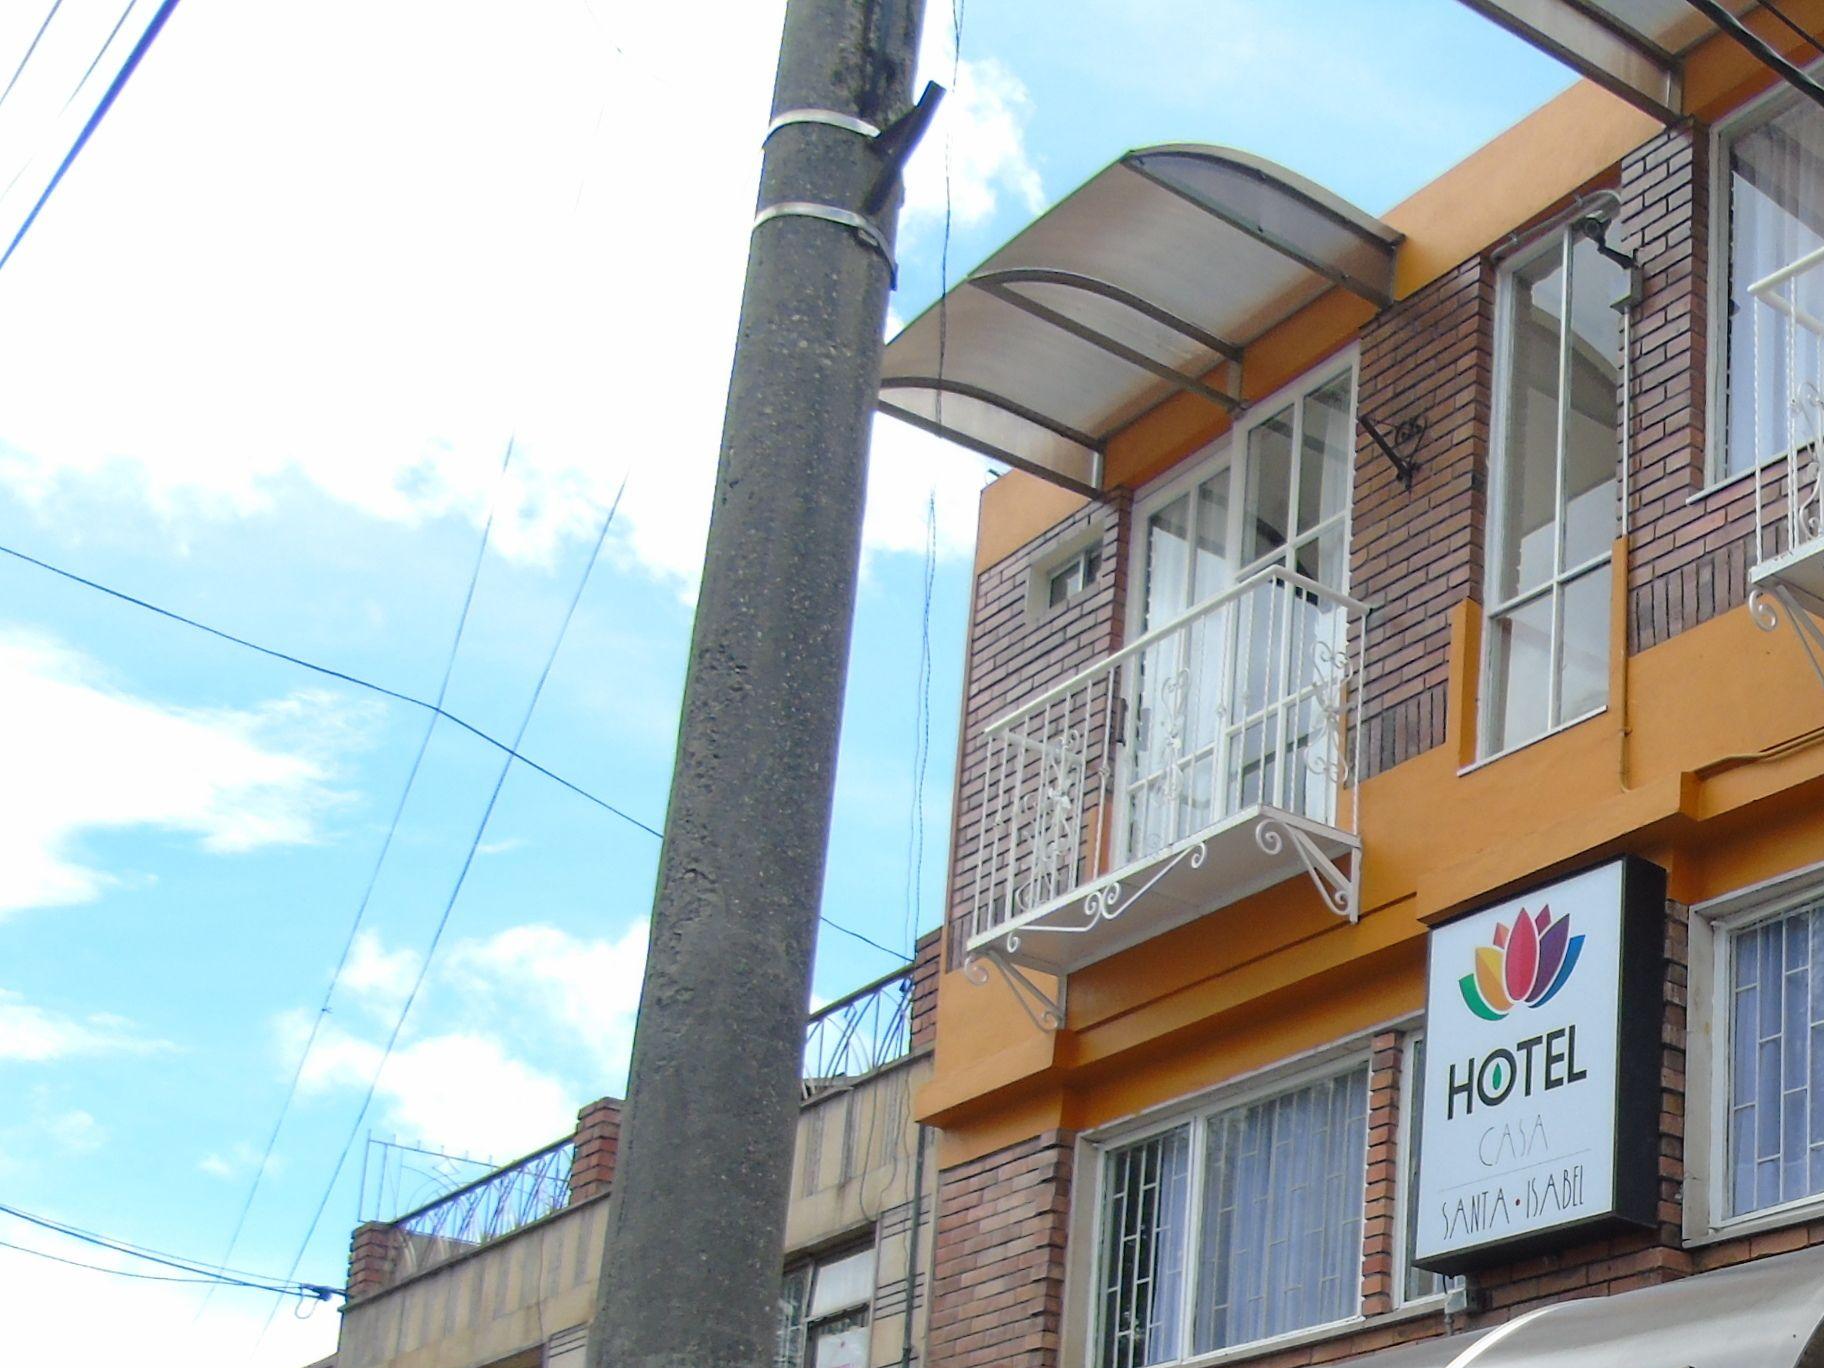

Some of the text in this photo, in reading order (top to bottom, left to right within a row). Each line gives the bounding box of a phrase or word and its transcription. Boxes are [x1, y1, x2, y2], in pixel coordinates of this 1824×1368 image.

[1446, 1024, 1588, 1121] HOTEL
[1477, 1114, 1551, 1167] CASA
[1441, 1164, 1586, 1241] SANTA ISABEL
